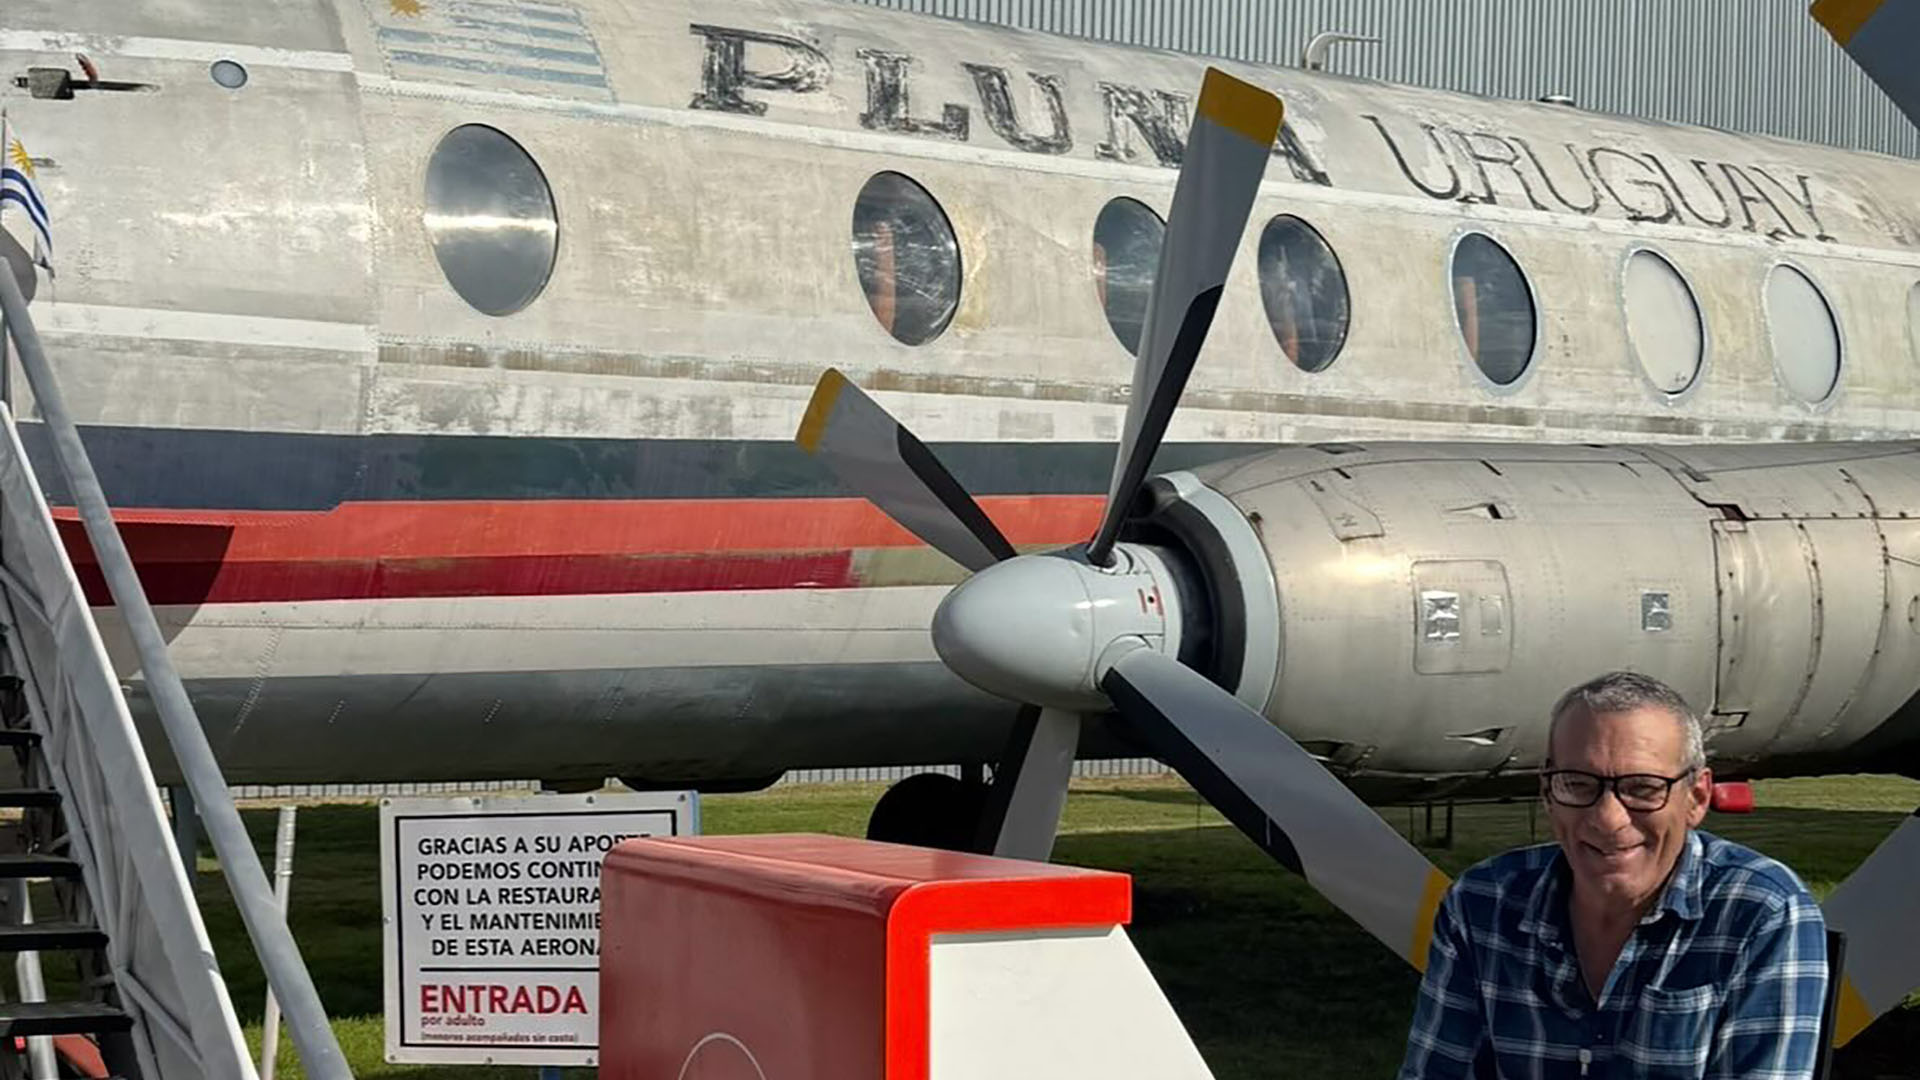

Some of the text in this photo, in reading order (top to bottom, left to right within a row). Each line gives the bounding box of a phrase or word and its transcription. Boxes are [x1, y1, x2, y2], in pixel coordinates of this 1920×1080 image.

[1361, 113, 1838, 243] URUGUAY
[418, 834, 650, 855] GRACIAS A SU APO
[418, 862, 521, 880] PODEMOS
[414, 887, 601, 905] CON LA RESTAURA
[421, 912, 601, 930] Y EL MANTENIMIE
[432, 938, 600, 956] DE ESTA AERON
[420, 985, 588, 1014] ENTRADA
[421, 1015, 485, 1027] por adulto
